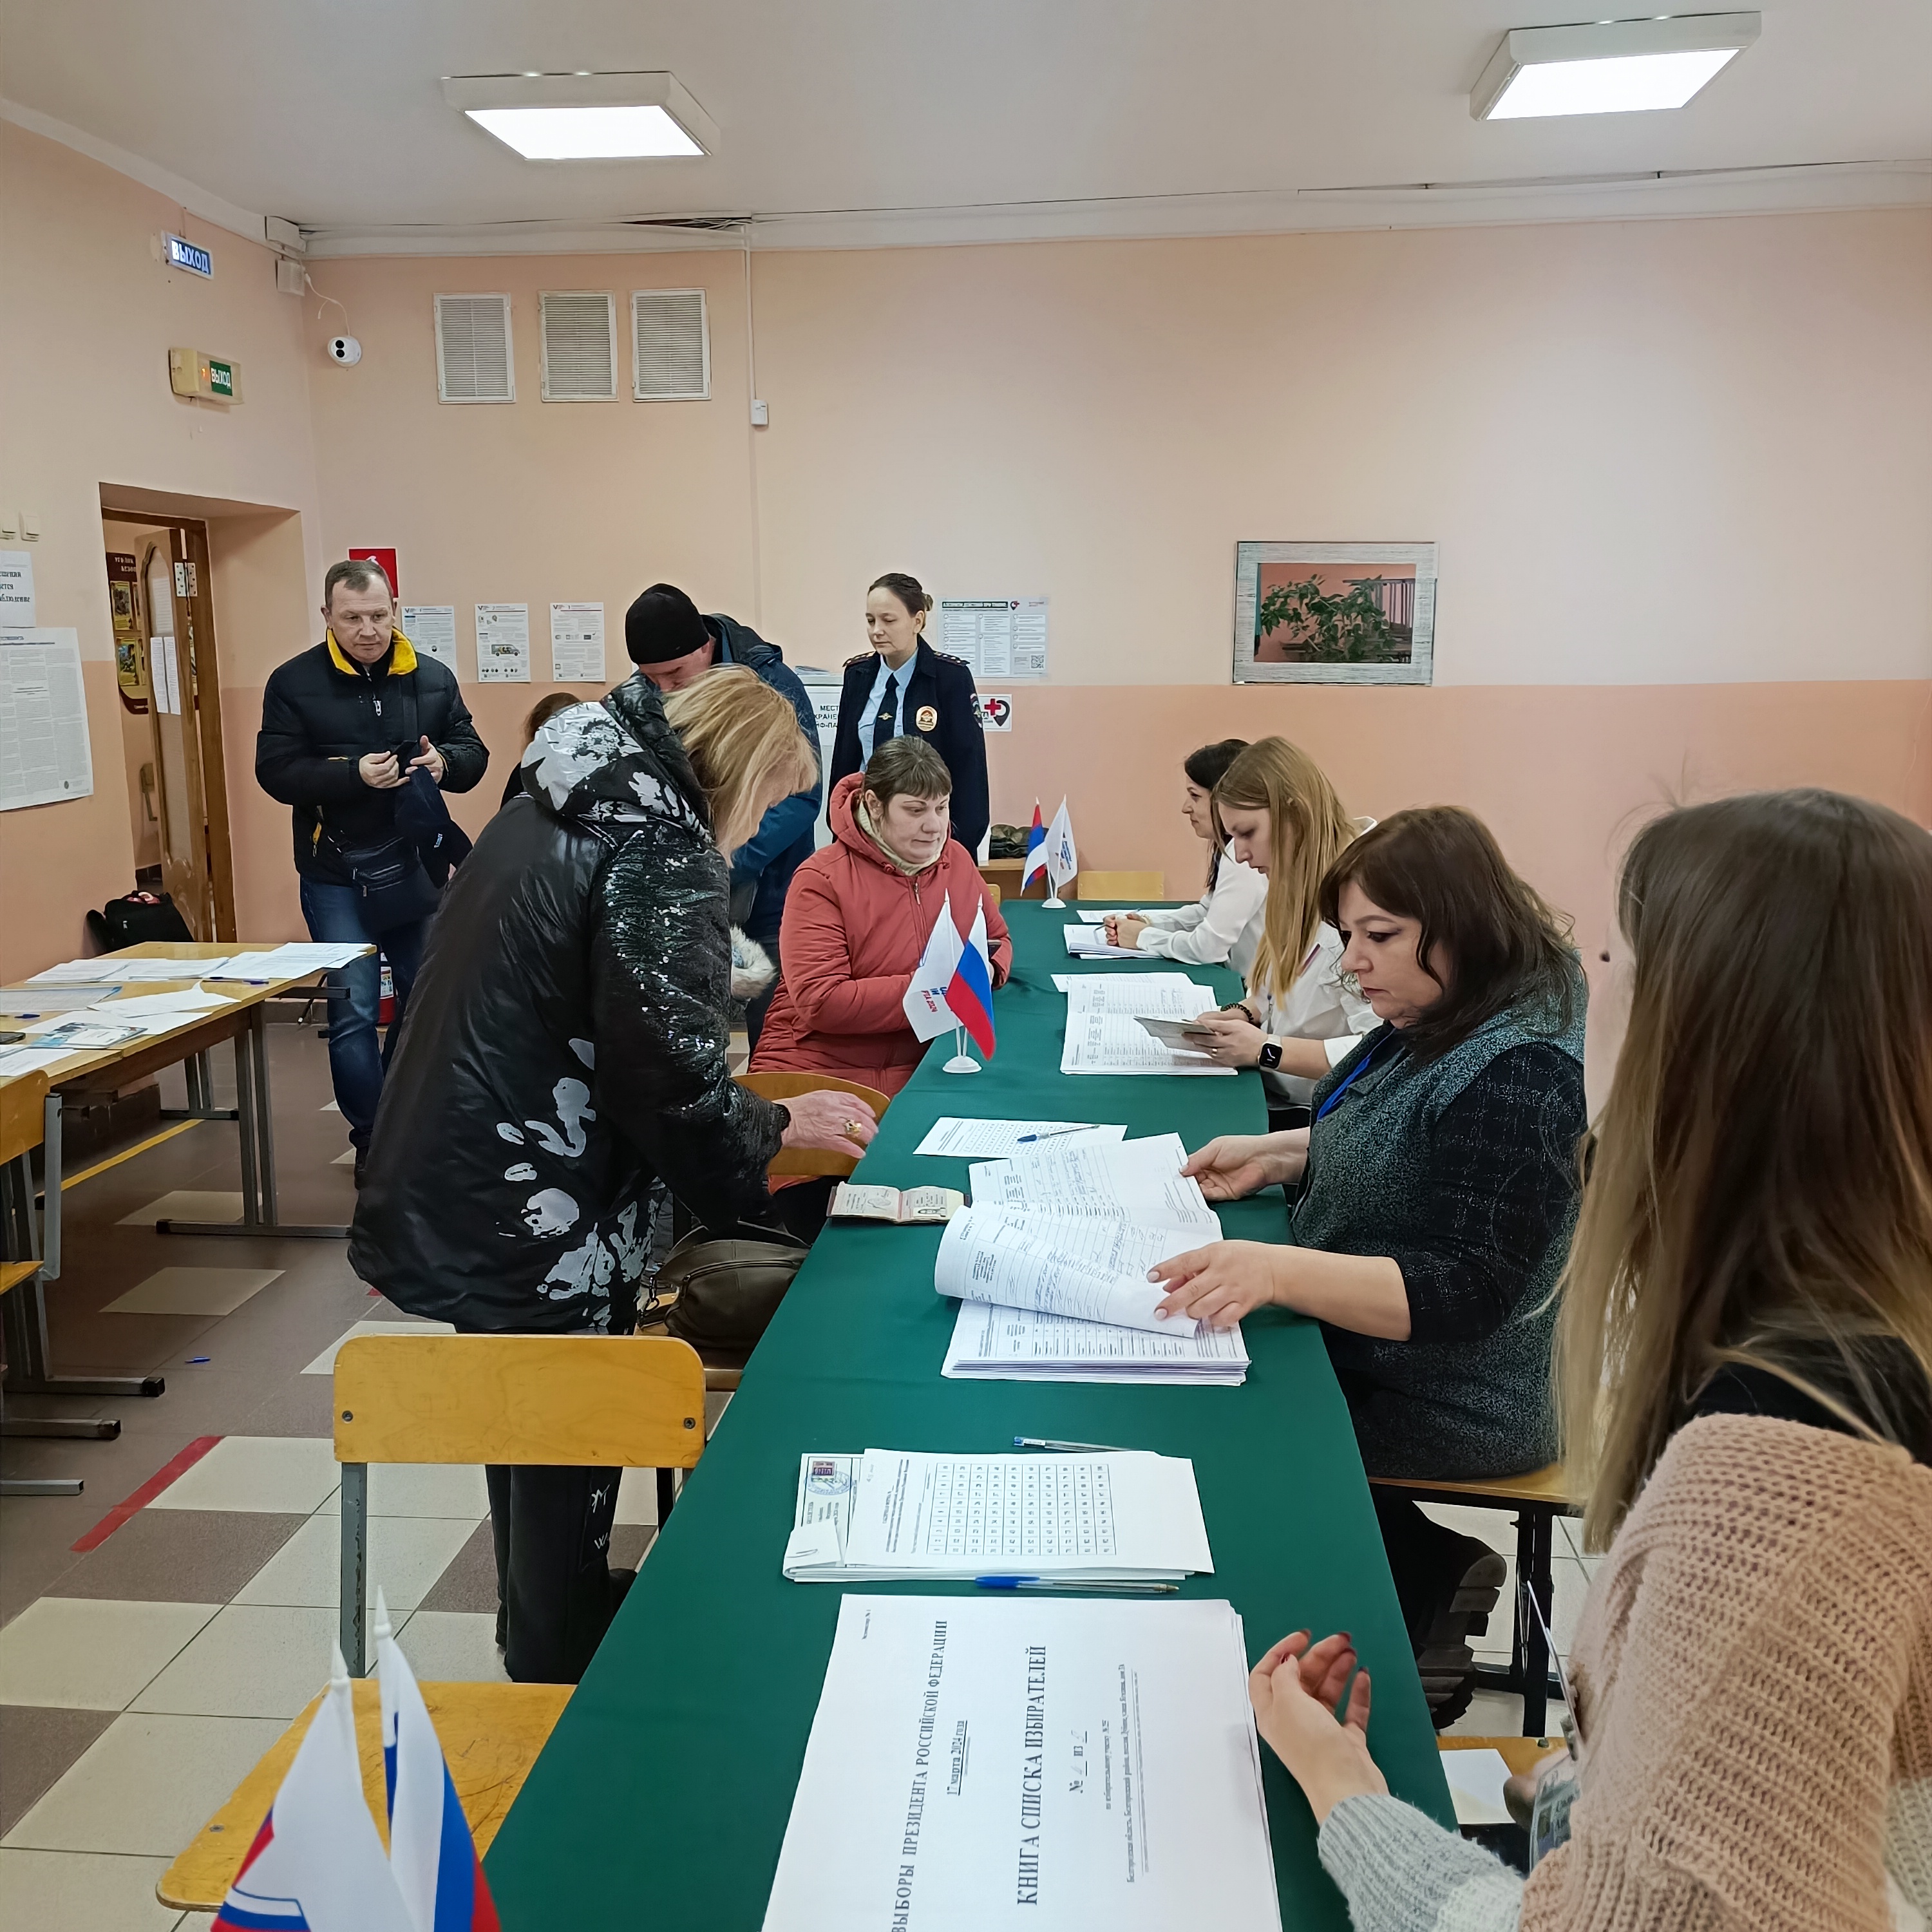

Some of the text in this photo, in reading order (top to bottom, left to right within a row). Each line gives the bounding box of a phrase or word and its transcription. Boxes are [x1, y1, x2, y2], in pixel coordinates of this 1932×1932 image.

[171, 240, 209, 274] ВЫХОД
[211, 368, 231, 390] ВЫХОД
[947, 1720, 965, 1795] 17 марта 2024 года
[1074, 1745, 1083, 1757] из
[891, 1620, 947, 1932] ВЫБОРЫ ПРЕЗИДЕНТА РОССИЙСКОЙ ФЕДЕРАЦИИ
[1017, 1645, 1046, 1907] КНИГА СПИСКА ИЗБИРАТЕЛЕЙ
[1069, 1780, 1083, 1794] №
